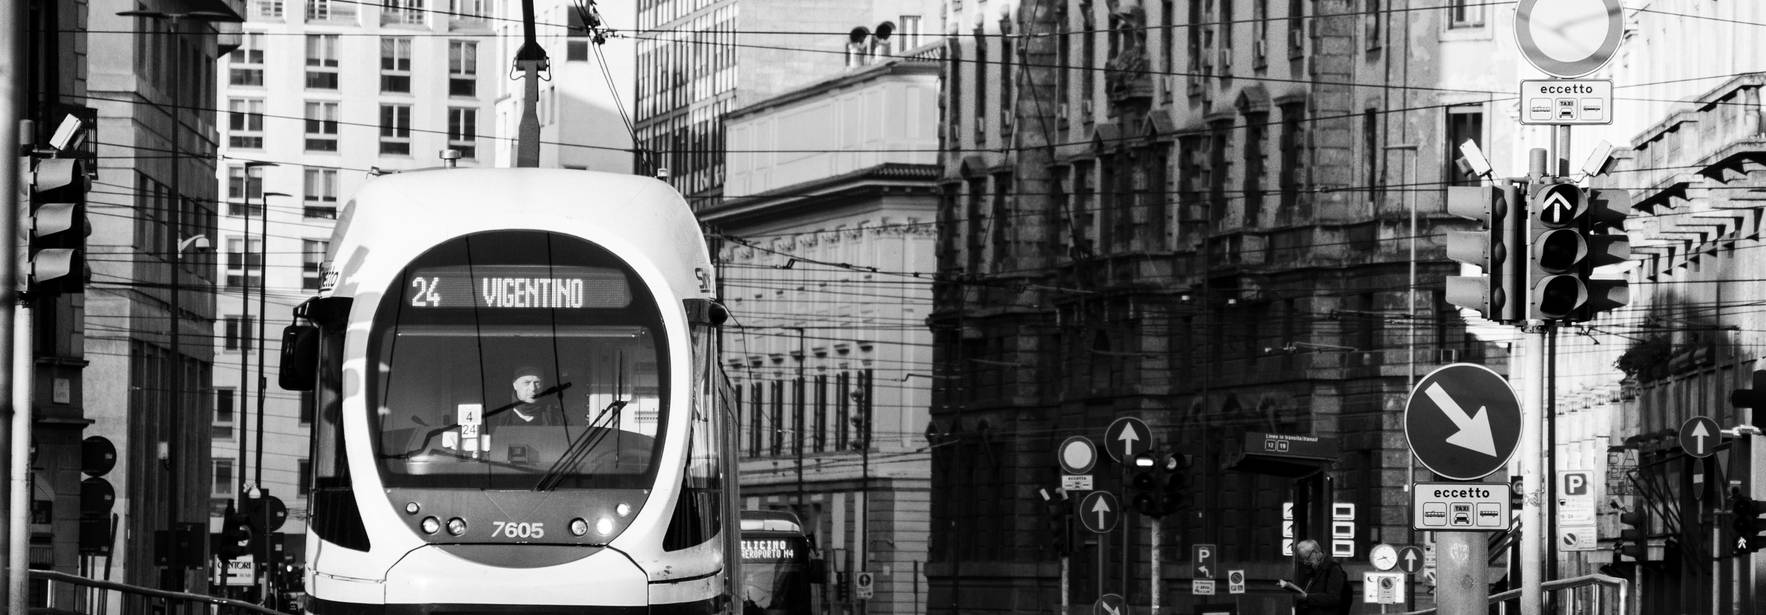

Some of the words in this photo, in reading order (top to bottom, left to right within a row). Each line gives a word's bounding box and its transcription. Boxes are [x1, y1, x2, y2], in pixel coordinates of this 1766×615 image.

[1540, 84, 1593, 94] eccetto
[412, 276, 440, 307] 24
[482, 277, 583, 308] VIGENTINO
[466, 411, 473, 422] 4
[463, 424, 476, 435] 24
[1569, 475, 1583, 494] P
[1433, 487, 1490, 499] eccetto
[491, 521, 545, 539] 7605
[1199, 549, 1210, 563] P
